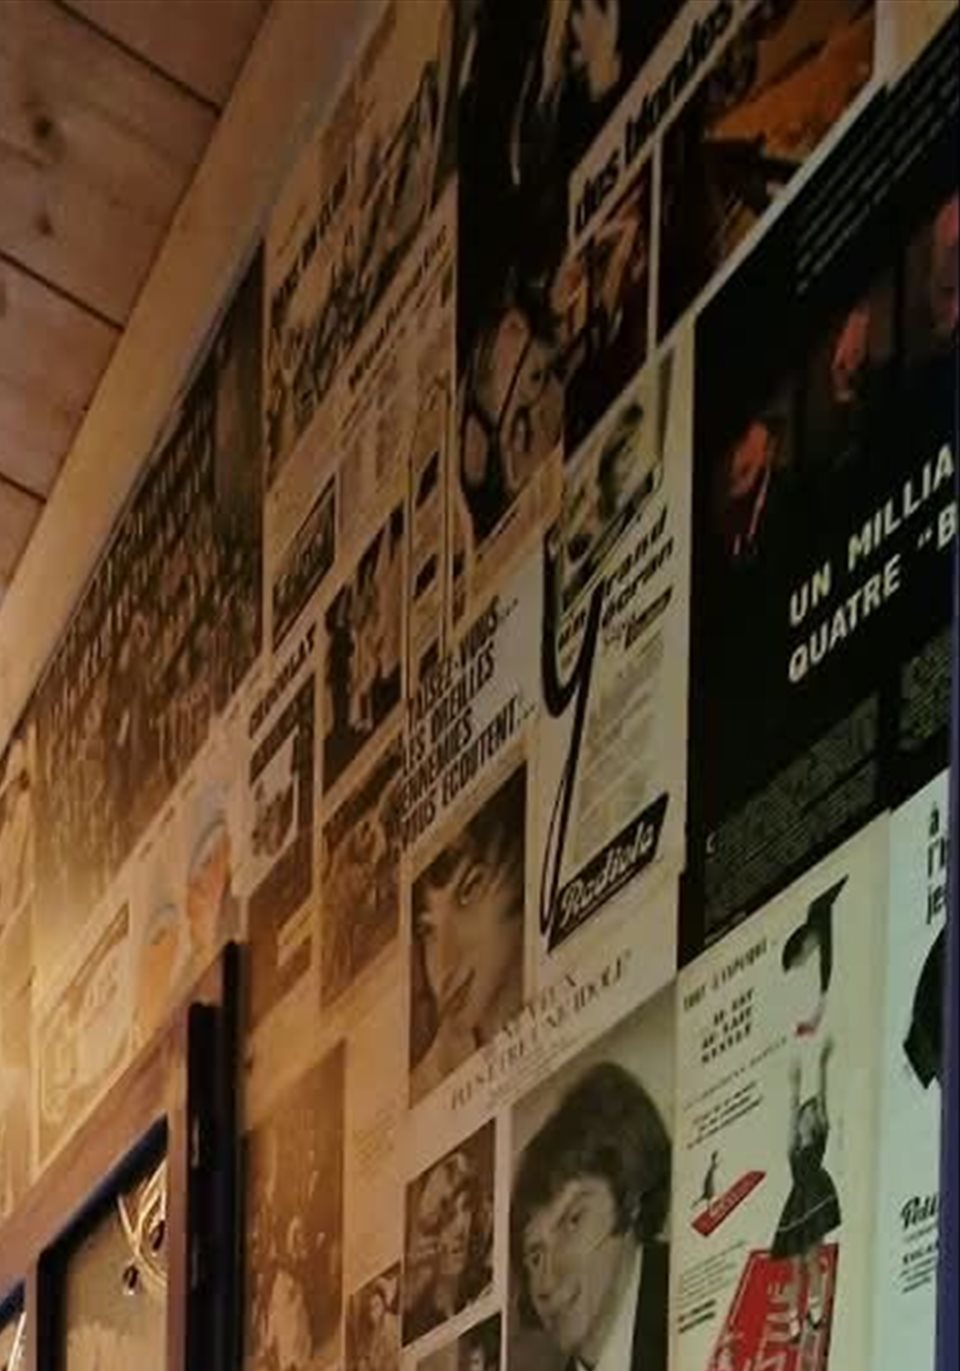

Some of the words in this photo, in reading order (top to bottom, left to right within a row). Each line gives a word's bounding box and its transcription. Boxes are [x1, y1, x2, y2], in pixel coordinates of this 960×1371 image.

[789, 552, 901, 684] QUATRE
[791, 561, 831, 627] UN
[559, 819, 655, 930] Radiola
